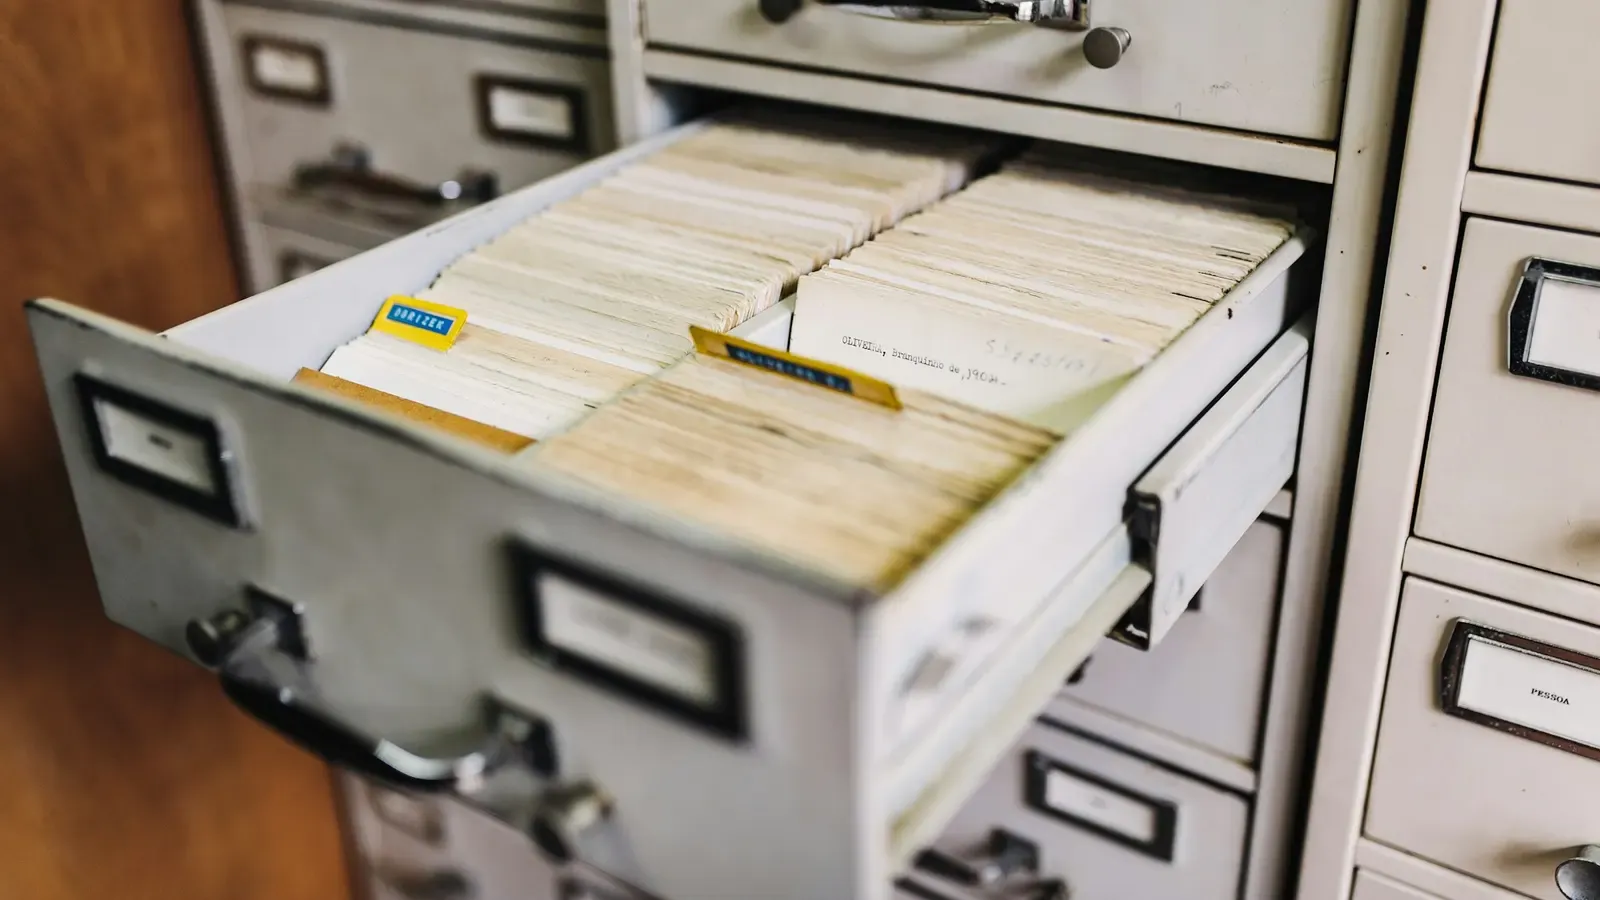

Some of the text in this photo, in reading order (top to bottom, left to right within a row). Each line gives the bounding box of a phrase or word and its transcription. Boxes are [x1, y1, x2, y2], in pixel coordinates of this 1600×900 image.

[842, 336, 886, 356] OLIVEIRA,
[892, 348, 944, 370] Branquinho
[1531, 688, 1570, 705] PESSOA
